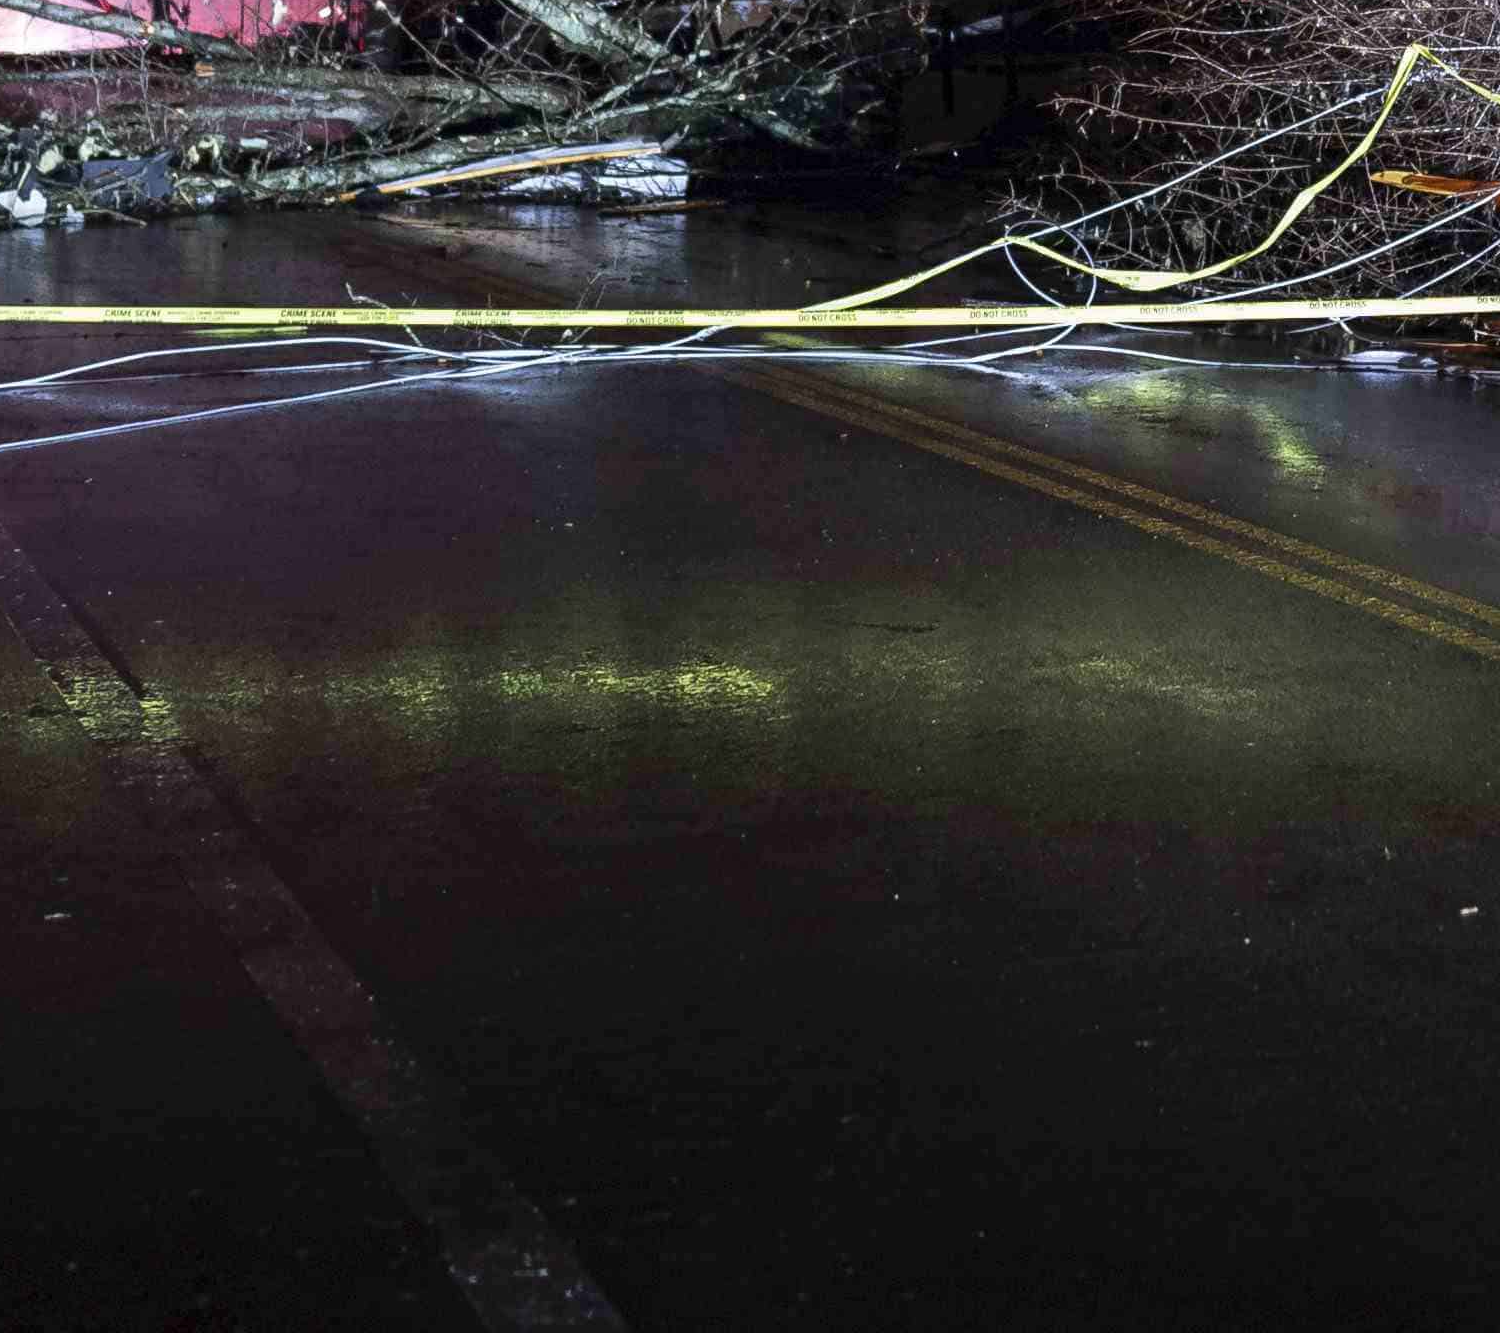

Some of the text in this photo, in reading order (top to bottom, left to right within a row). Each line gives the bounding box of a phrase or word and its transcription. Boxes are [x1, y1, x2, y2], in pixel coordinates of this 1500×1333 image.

[105, 309, 132, 317] CRIME
[135, 309, 162, 317] SCENE
[983, 310, 998, 318] NOT
[626, 317, 684, 325] DO NOT CROSS
[798, 314, 810, 322] DO
[812, 314, 828, 322] NOT
